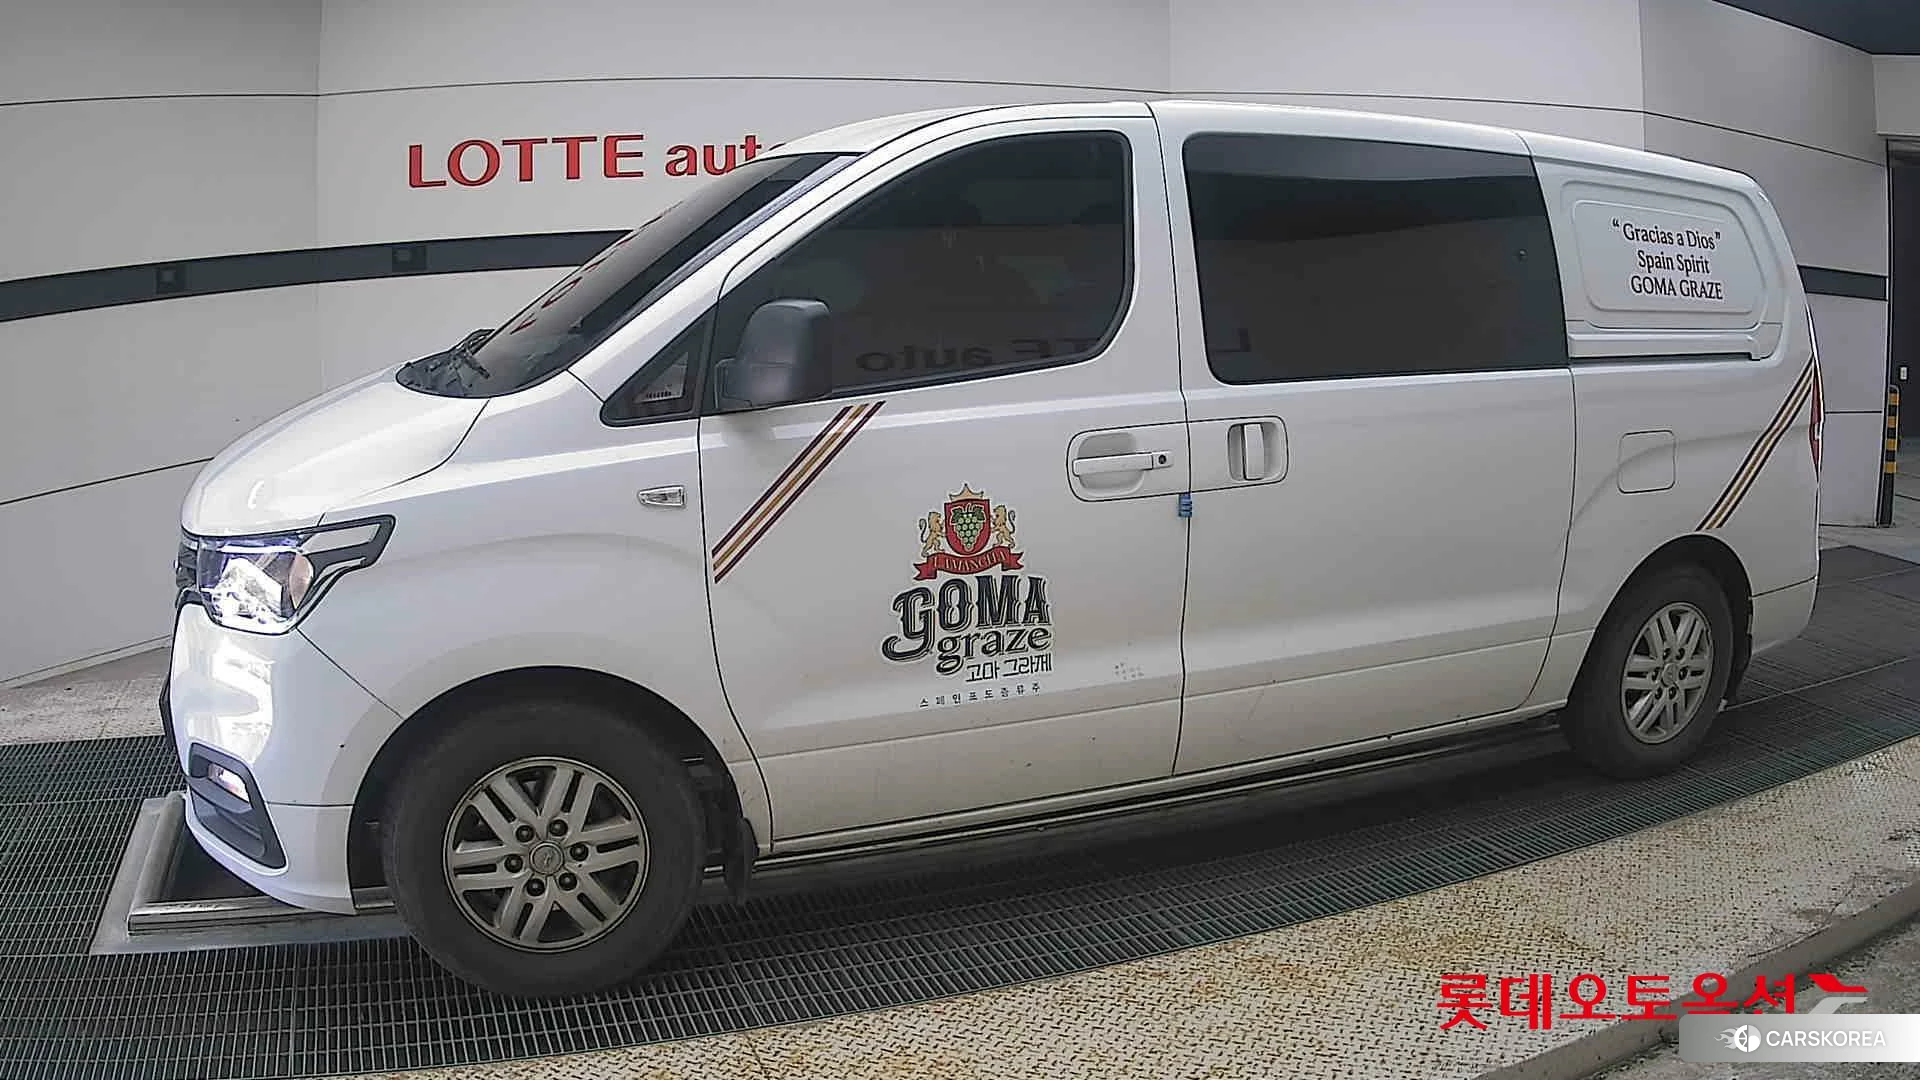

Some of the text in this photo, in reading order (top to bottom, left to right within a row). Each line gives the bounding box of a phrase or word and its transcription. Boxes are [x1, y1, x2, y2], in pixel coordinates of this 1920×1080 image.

[409, 134, 787, 188] LOTTE aut
[1677, 233, 1684, 246] a
[1637, 250, 1710, 276] Spain Spirit
[1631, 275, 1723, 300] GOMA GRAZE
[882, 575, 1051, 661] GOMA
[936, 627, 1051, 675] graze
[965, 660, 1000, 682] 고마
